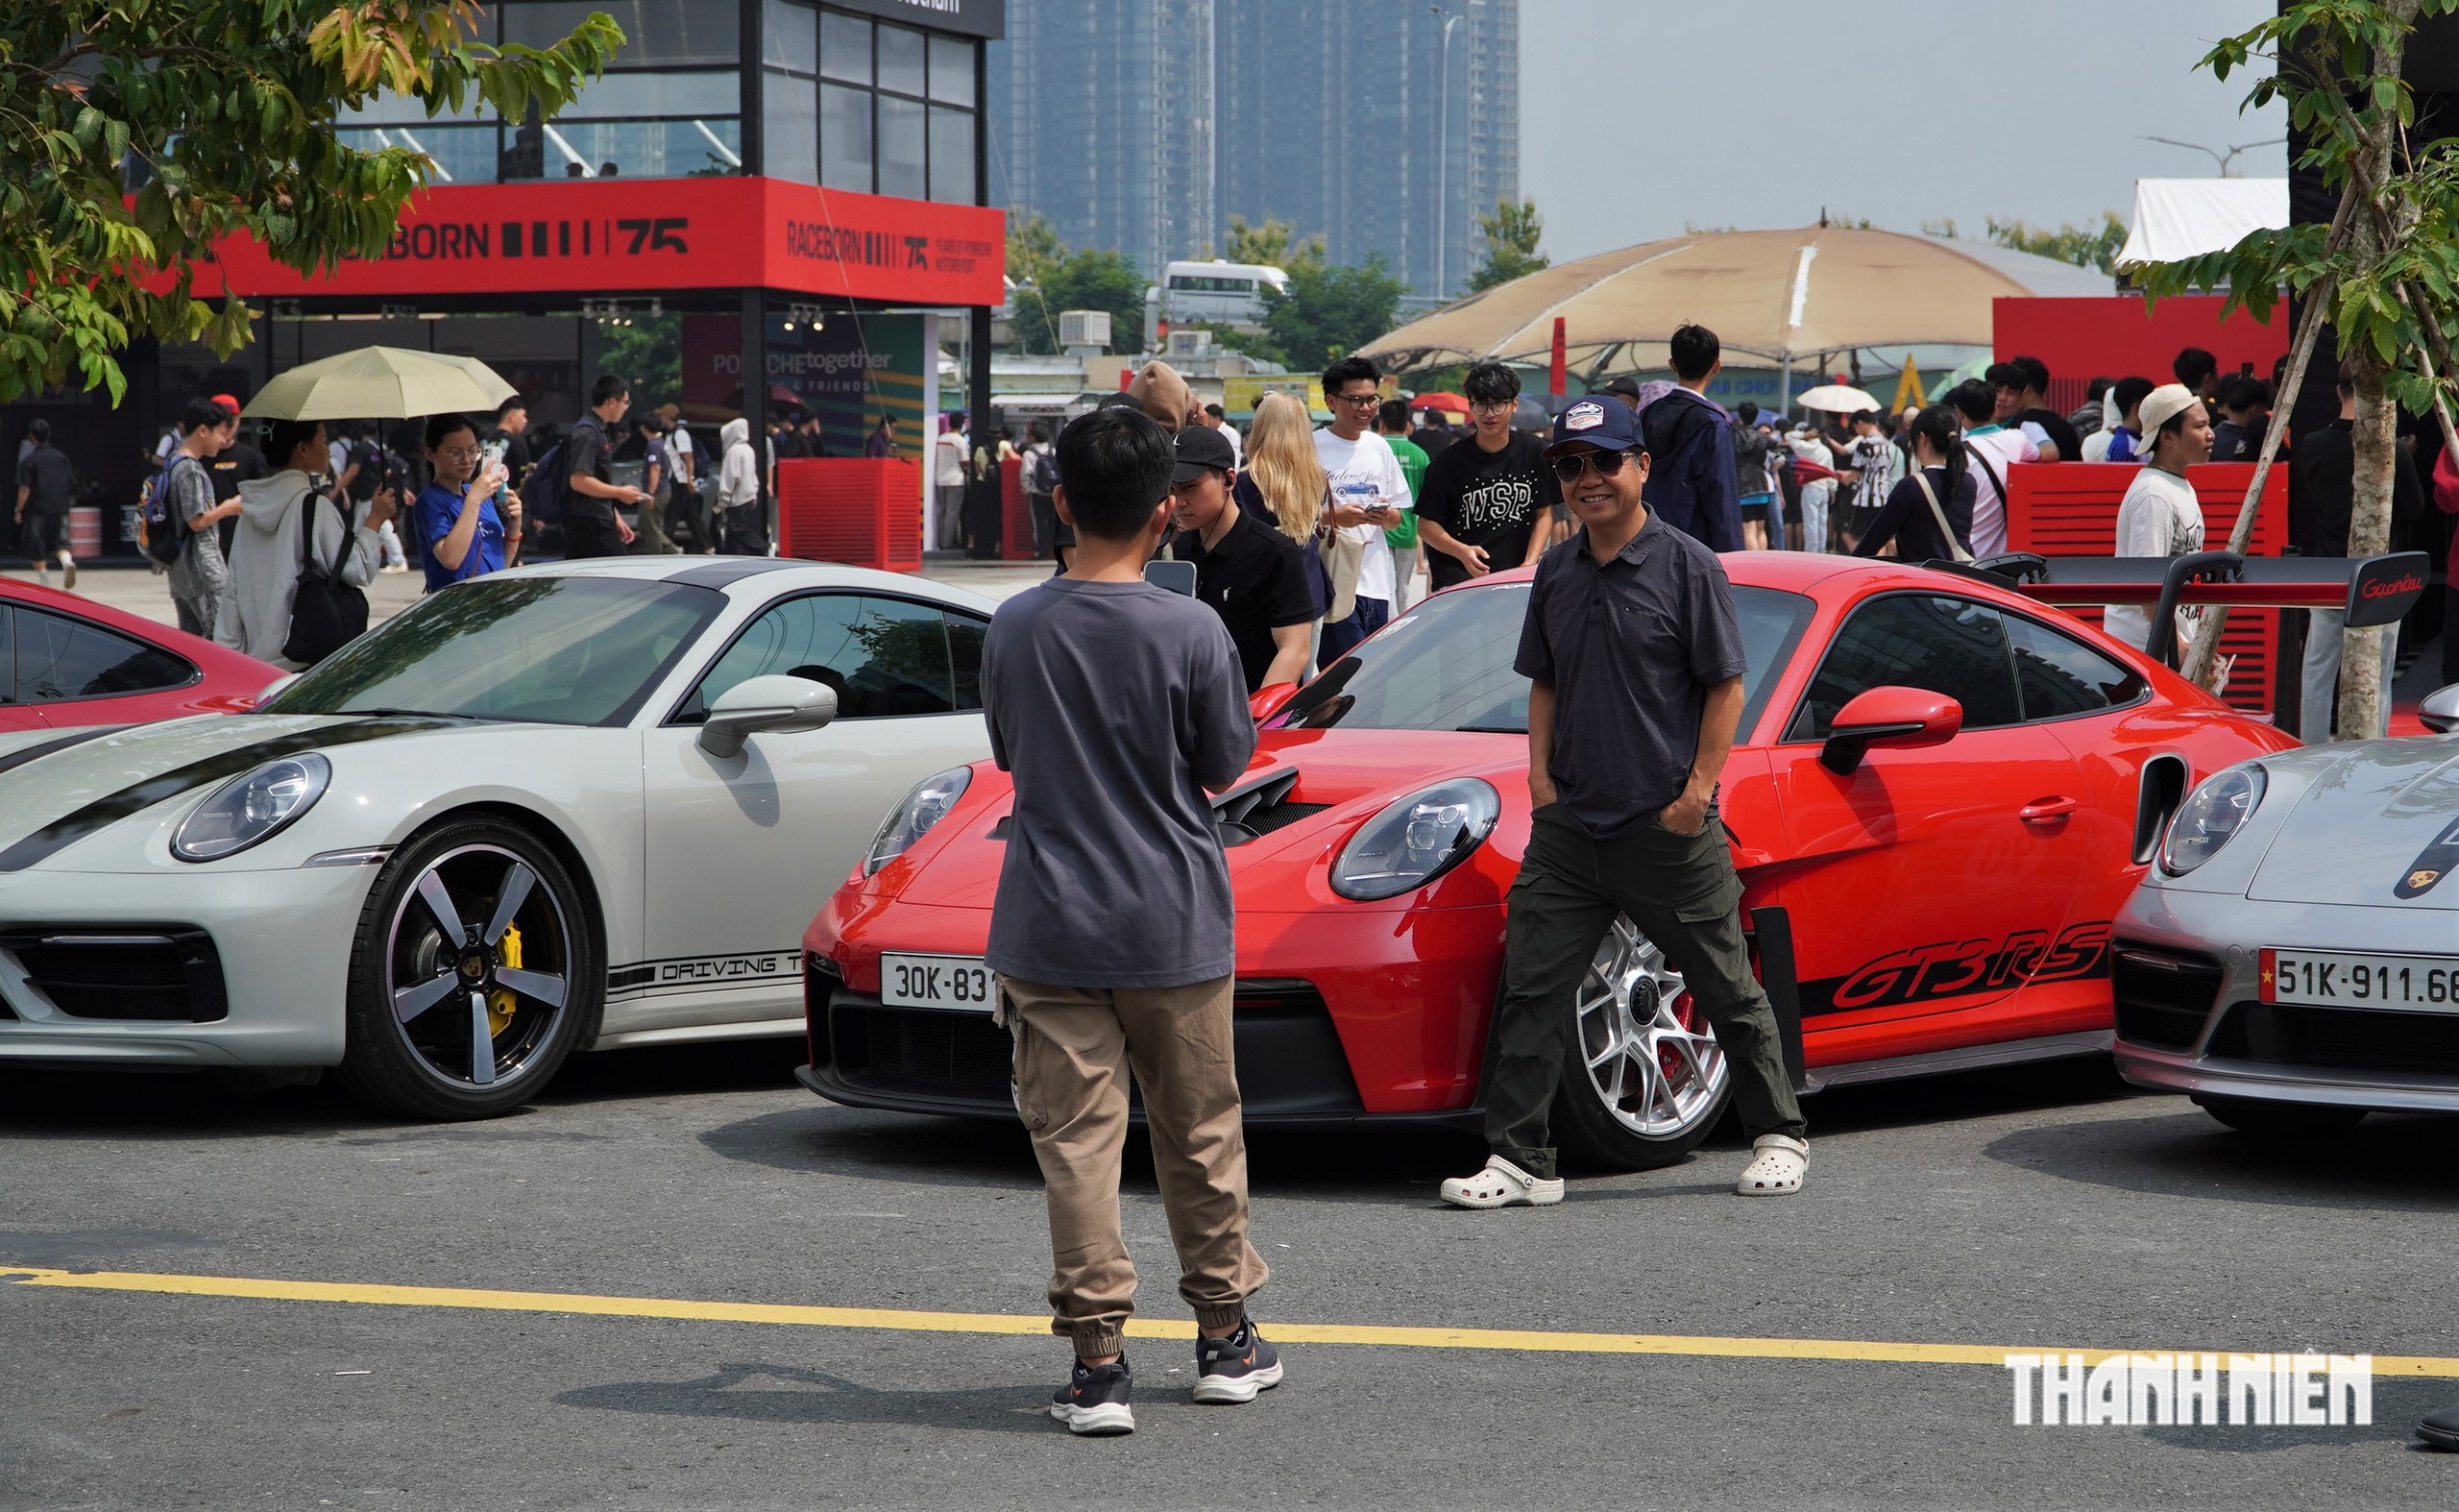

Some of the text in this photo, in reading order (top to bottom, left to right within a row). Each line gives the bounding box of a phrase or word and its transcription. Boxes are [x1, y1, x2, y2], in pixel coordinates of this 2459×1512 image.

[617, 217, 689, 255] 75
[787, 220, 928, 270] RACEBORN 75
[808, 380, 870, 392] FRIENDS
[1462, 482, 1531, 530] WSP
[663, 958, 776, 981] DRIVING
[895, 964, 995, 1002] 30K-83
